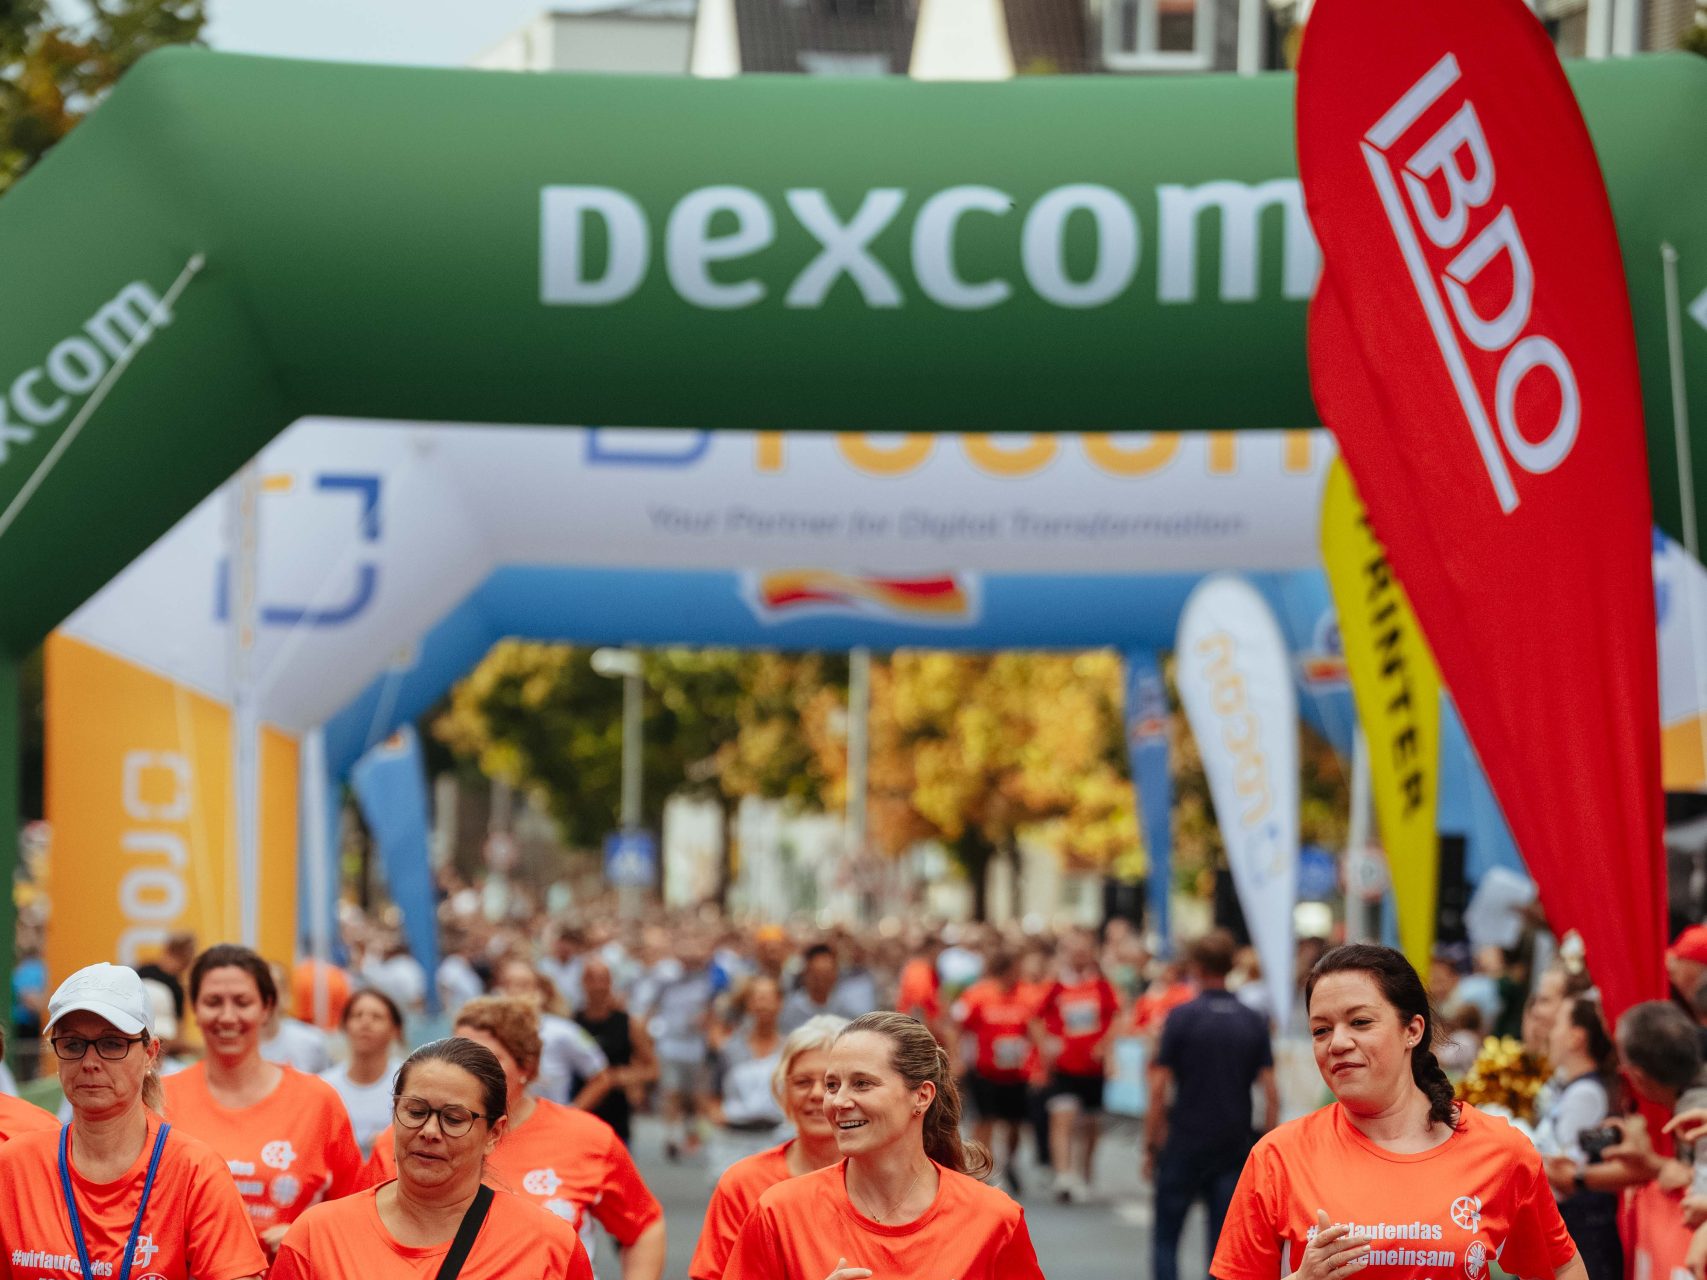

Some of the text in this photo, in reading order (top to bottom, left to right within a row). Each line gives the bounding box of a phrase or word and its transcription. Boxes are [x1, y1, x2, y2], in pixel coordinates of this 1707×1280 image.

[539, 179, 1323, 310] Dexcom
[1405, 99, 1581, 474] BDO
[12, 1249, 113, 1277] #wirlaufedas
